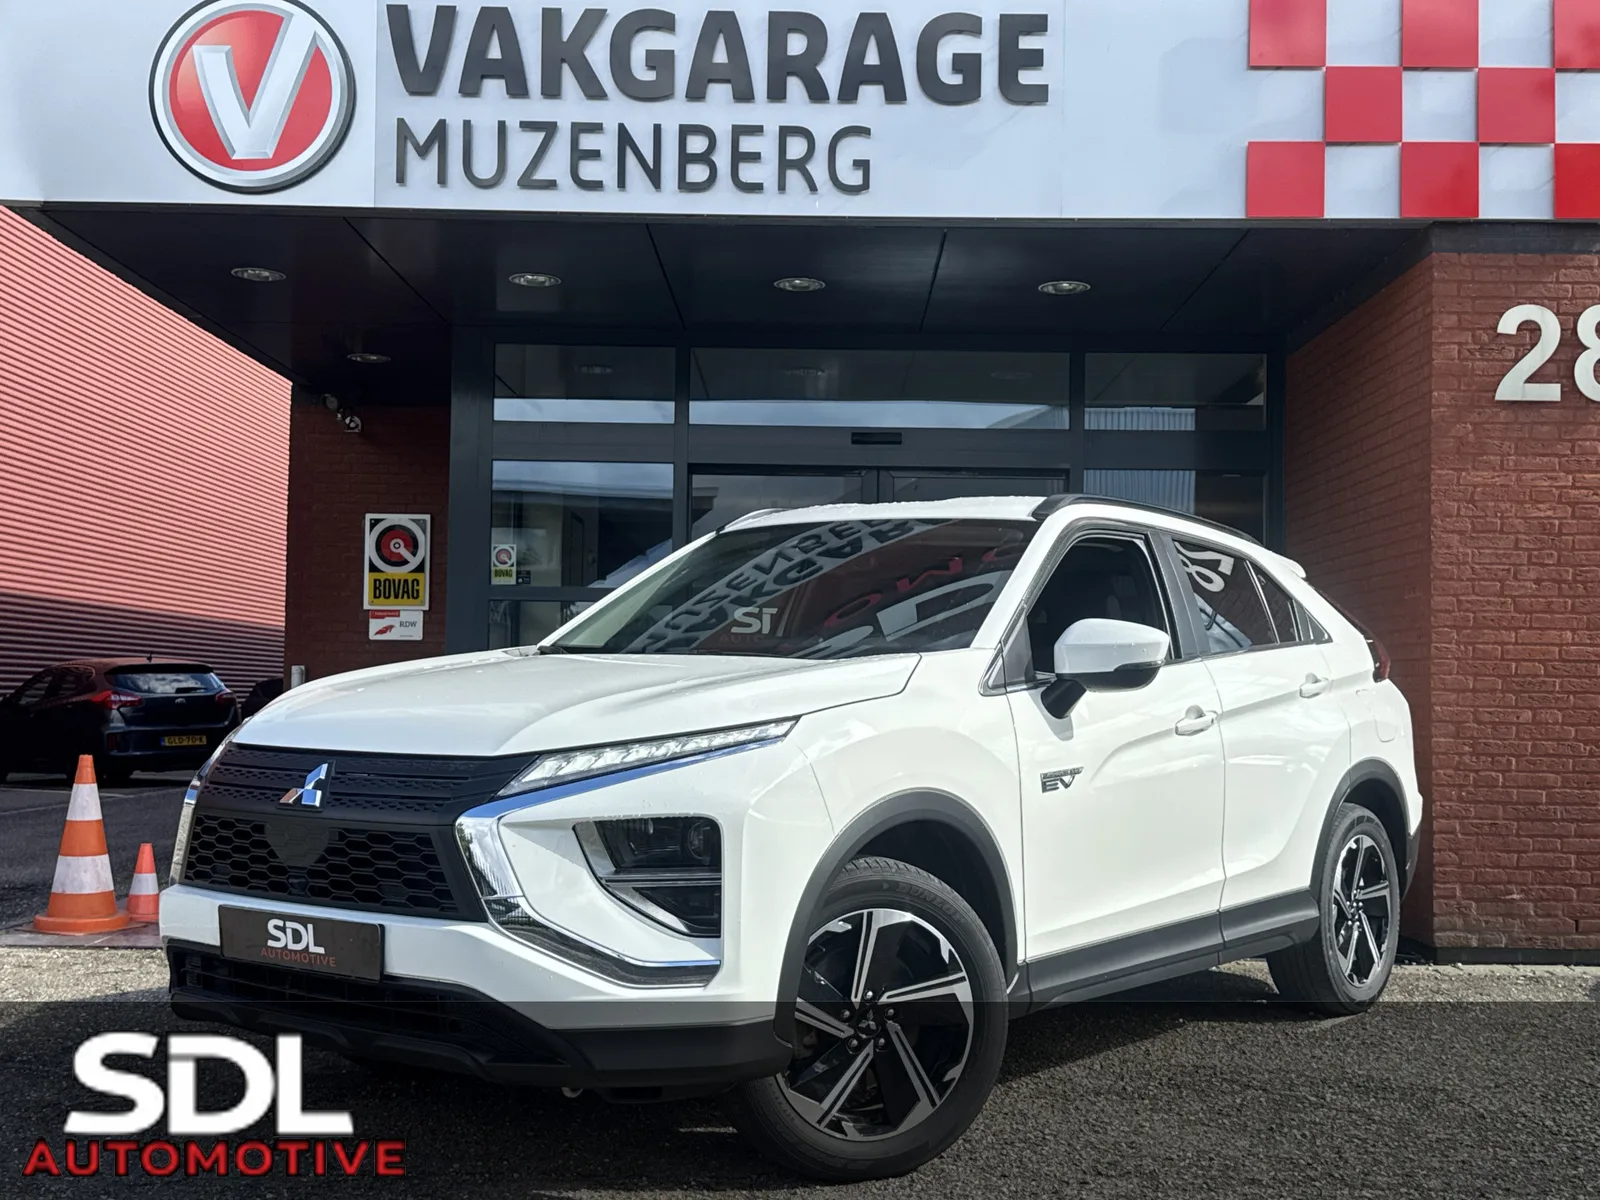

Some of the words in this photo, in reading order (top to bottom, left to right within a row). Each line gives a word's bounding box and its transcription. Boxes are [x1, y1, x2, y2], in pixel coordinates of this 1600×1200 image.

[386, 4, 1049, 105] VAKGARAGE
[396, 117, 872, 194] MUZENBERG
[495, 569, 512, 578] BOVAG
[373, 578, 420, 600] BOVAG
[399, 620, 418, 628] RDW
[267, 918, 325, 954] SDL
[260, 947, 336, 967] AUTOMOTIVE
